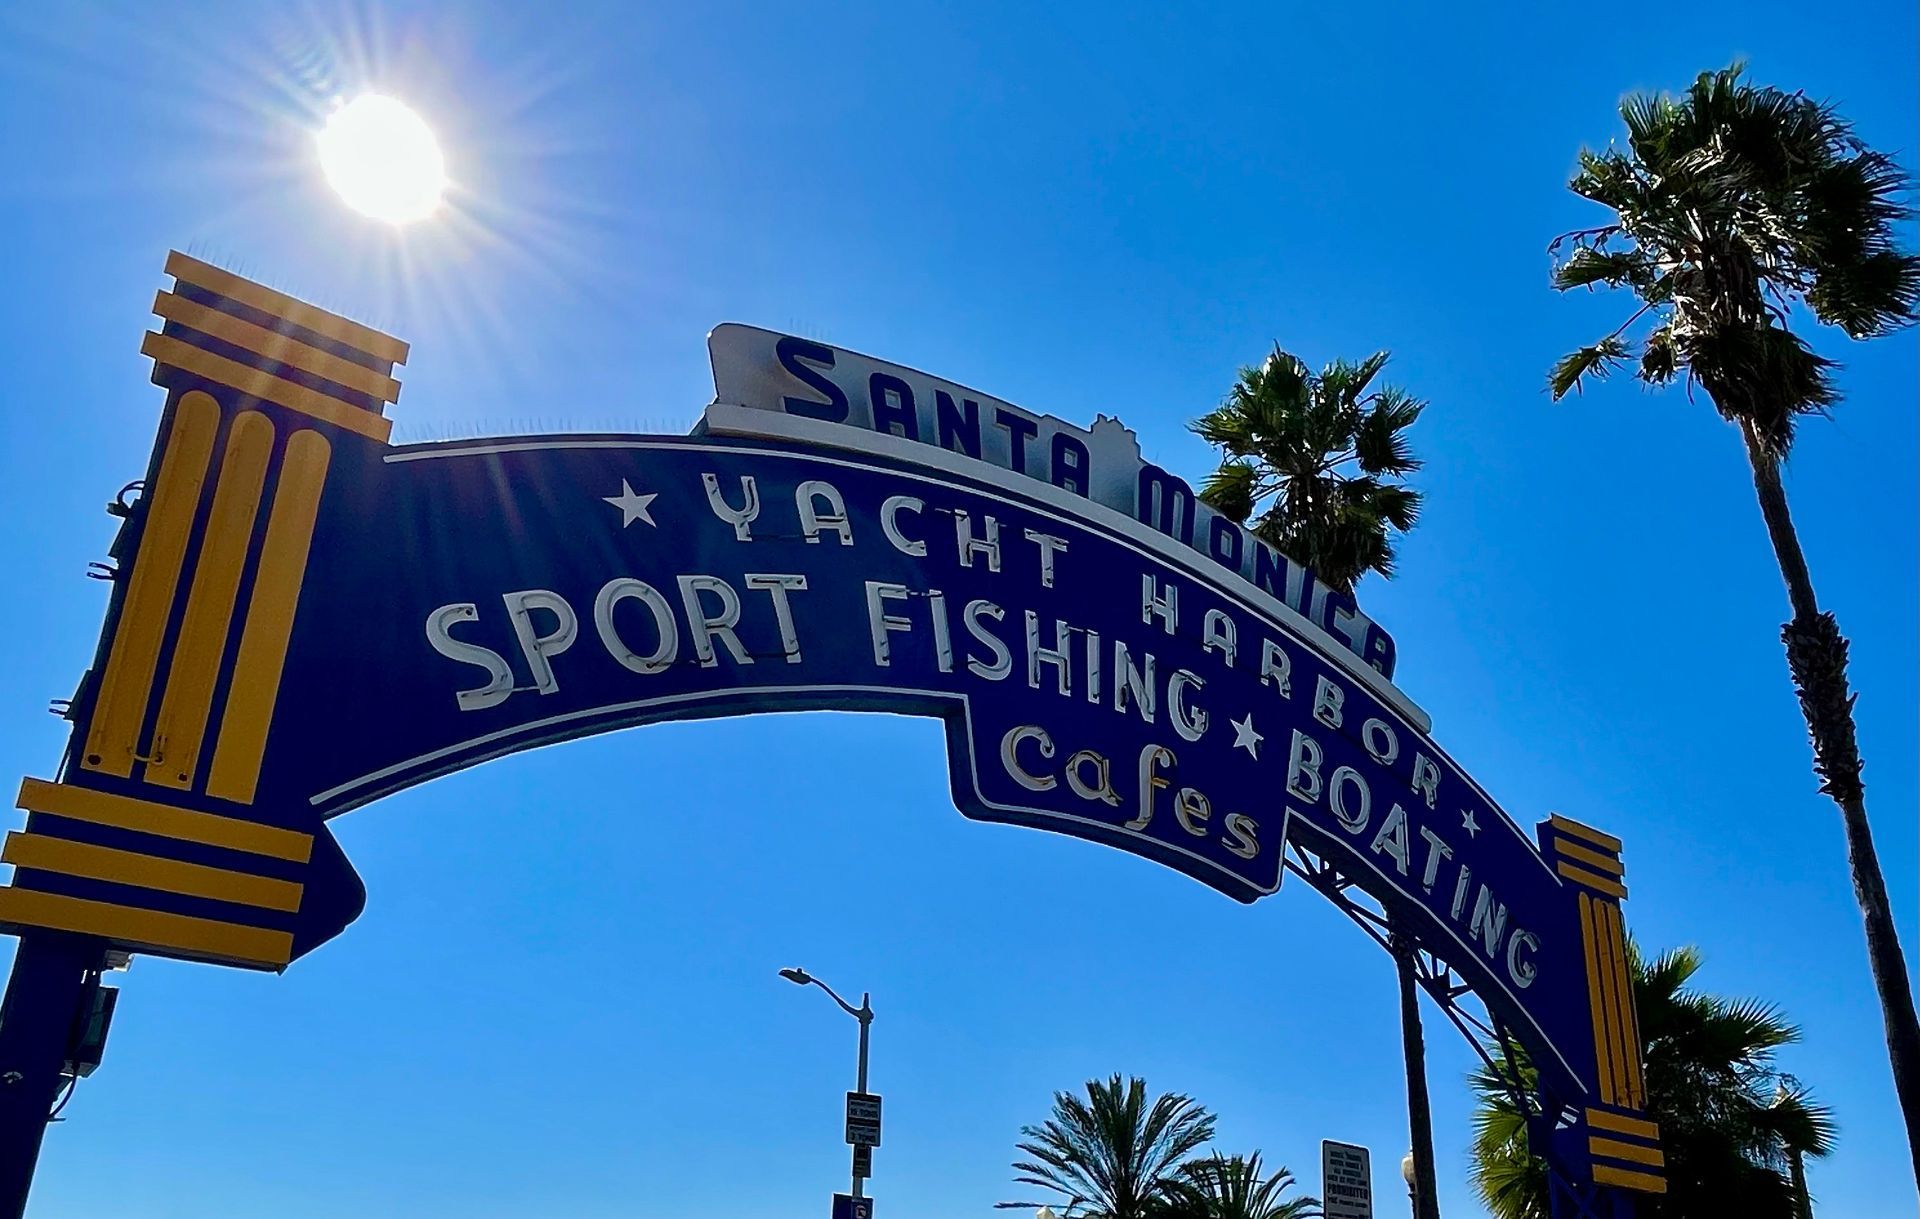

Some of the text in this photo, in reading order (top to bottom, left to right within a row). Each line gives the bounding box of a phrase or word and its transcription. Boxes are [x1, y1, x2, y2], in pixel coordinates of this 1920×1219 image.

[702, 473, 1442, 809] YACHT HARBOR
[775, 337, 1396, 682] SANTA MONICA
[426, 573, 1541, 988] SPORT FISHING BOATING
[1000, 725, 1260, 859] Cafes
